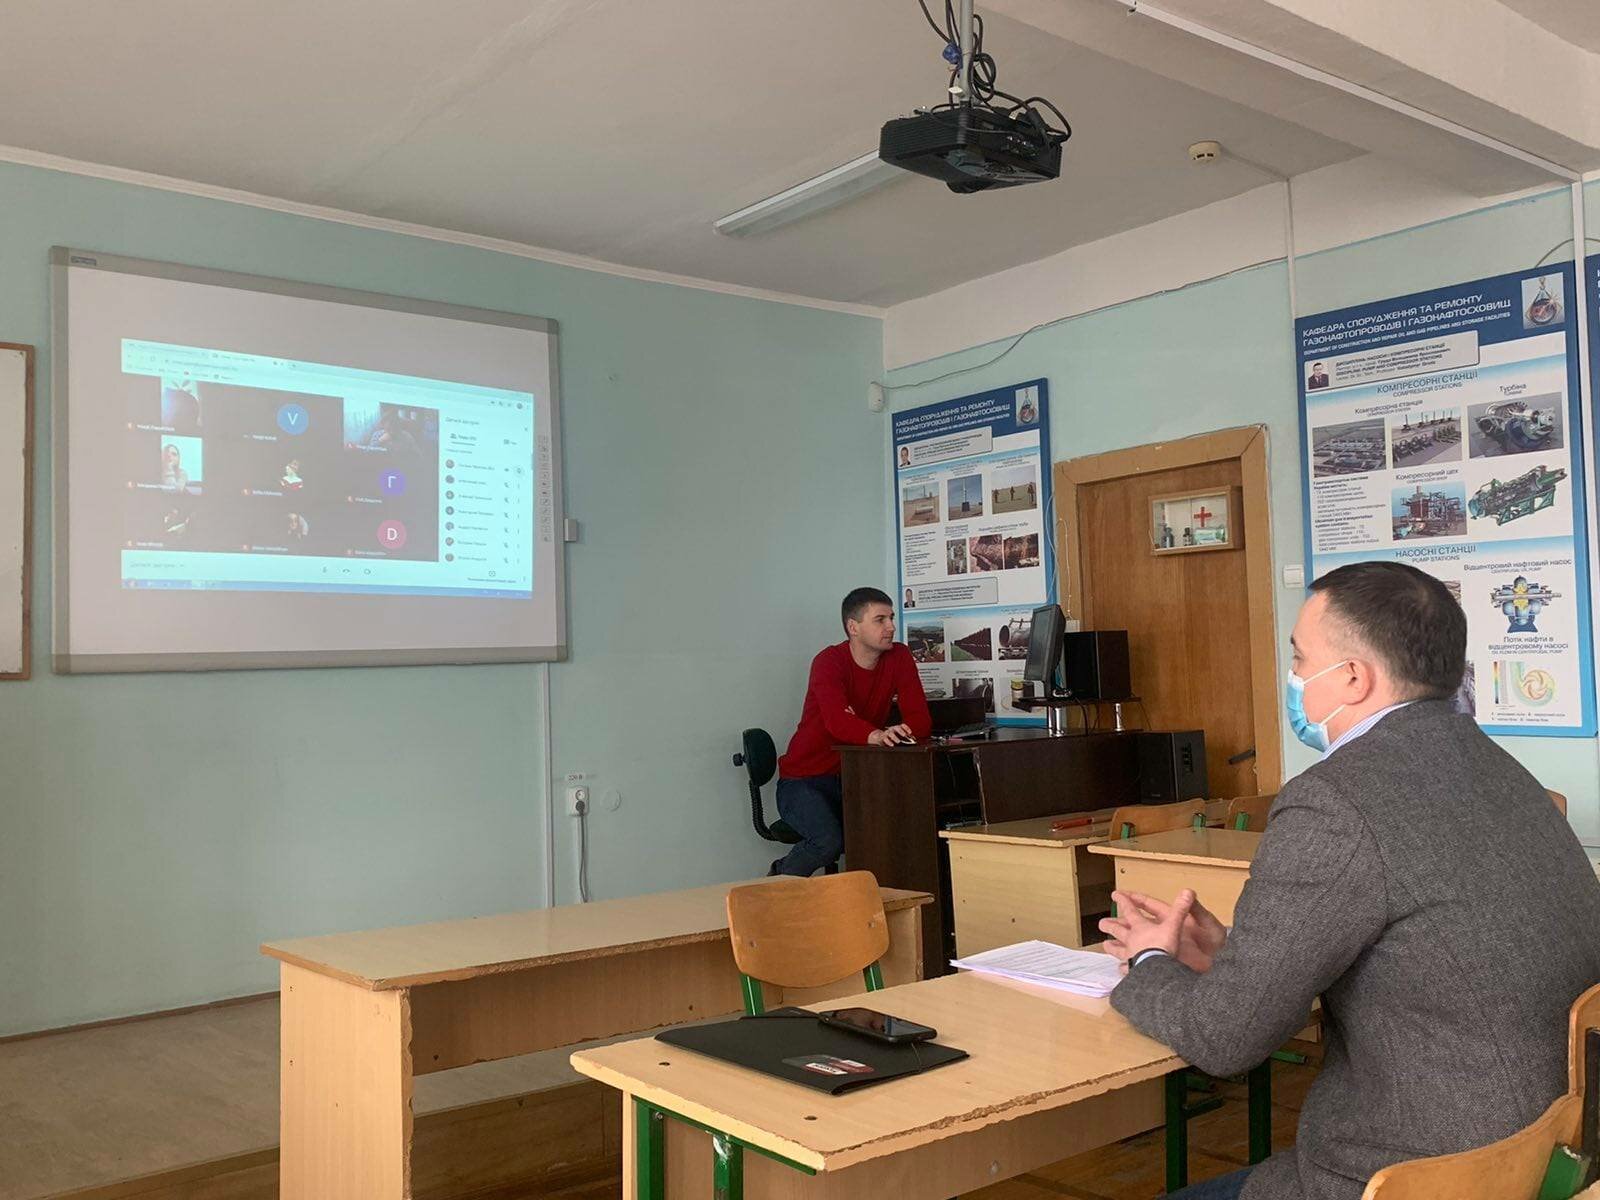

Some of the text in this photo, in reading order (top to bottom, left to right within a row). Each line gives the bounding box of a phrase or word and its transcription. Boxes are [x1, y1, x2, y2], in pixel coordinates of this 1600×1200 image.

[1302, 293, 1483, 338] КАФЕДРА СПОРУДЖЕННЯ ТА РЕМОНТУ
[1303, 320, 1402, 346] ГАЗОНАФТОПРОВОДІВ
[1408, 298, 1511, 326] ГАЗОНАФТОСХОВИЩ
[1377, 370, 1478, 394] КОМПРЕСОРНІ СТАНЦІЇ
[1392, 381, 1463, 397] COMPRESSOR STATIONS
[287, 412, 299, 426] V
[1396, 469, 1446, 480] Компресорний
[386, 527, 398, 541] D
[1395, 545, 1476, 557] НАСОСНІ СТАНЦІЇ
[1463, 558, 1572, 571] Відцентровий нафтовий насос
[1488, 643, 1543, 651] відцентровому
